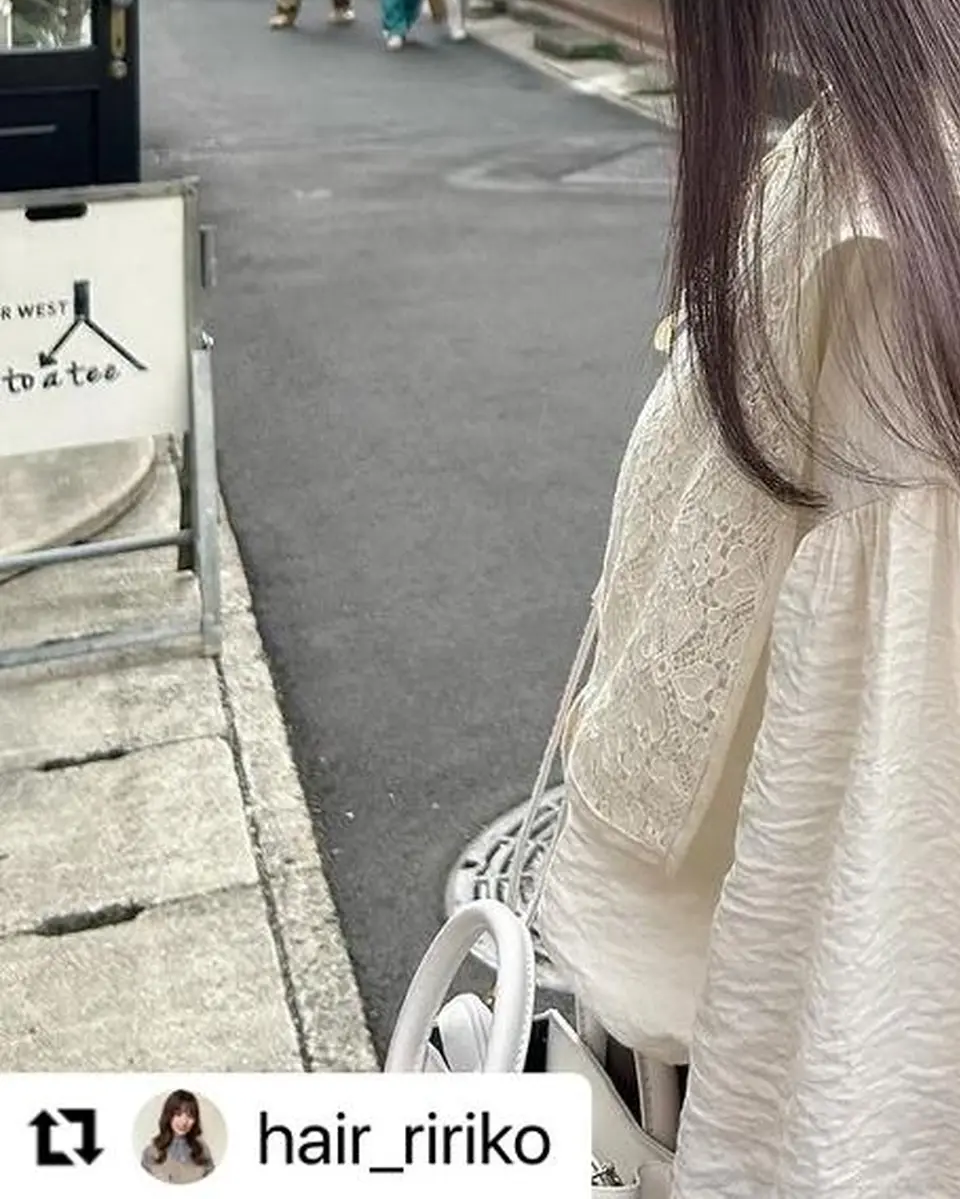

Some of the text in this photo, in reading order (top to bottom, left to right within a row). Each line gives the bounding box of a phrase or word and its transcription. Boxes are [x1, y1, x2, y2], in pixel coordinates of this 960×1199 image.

[18, 300, 68, 318] WEST
[2, 367, 35, 393] to
[65, 361, 119, 386] tee
